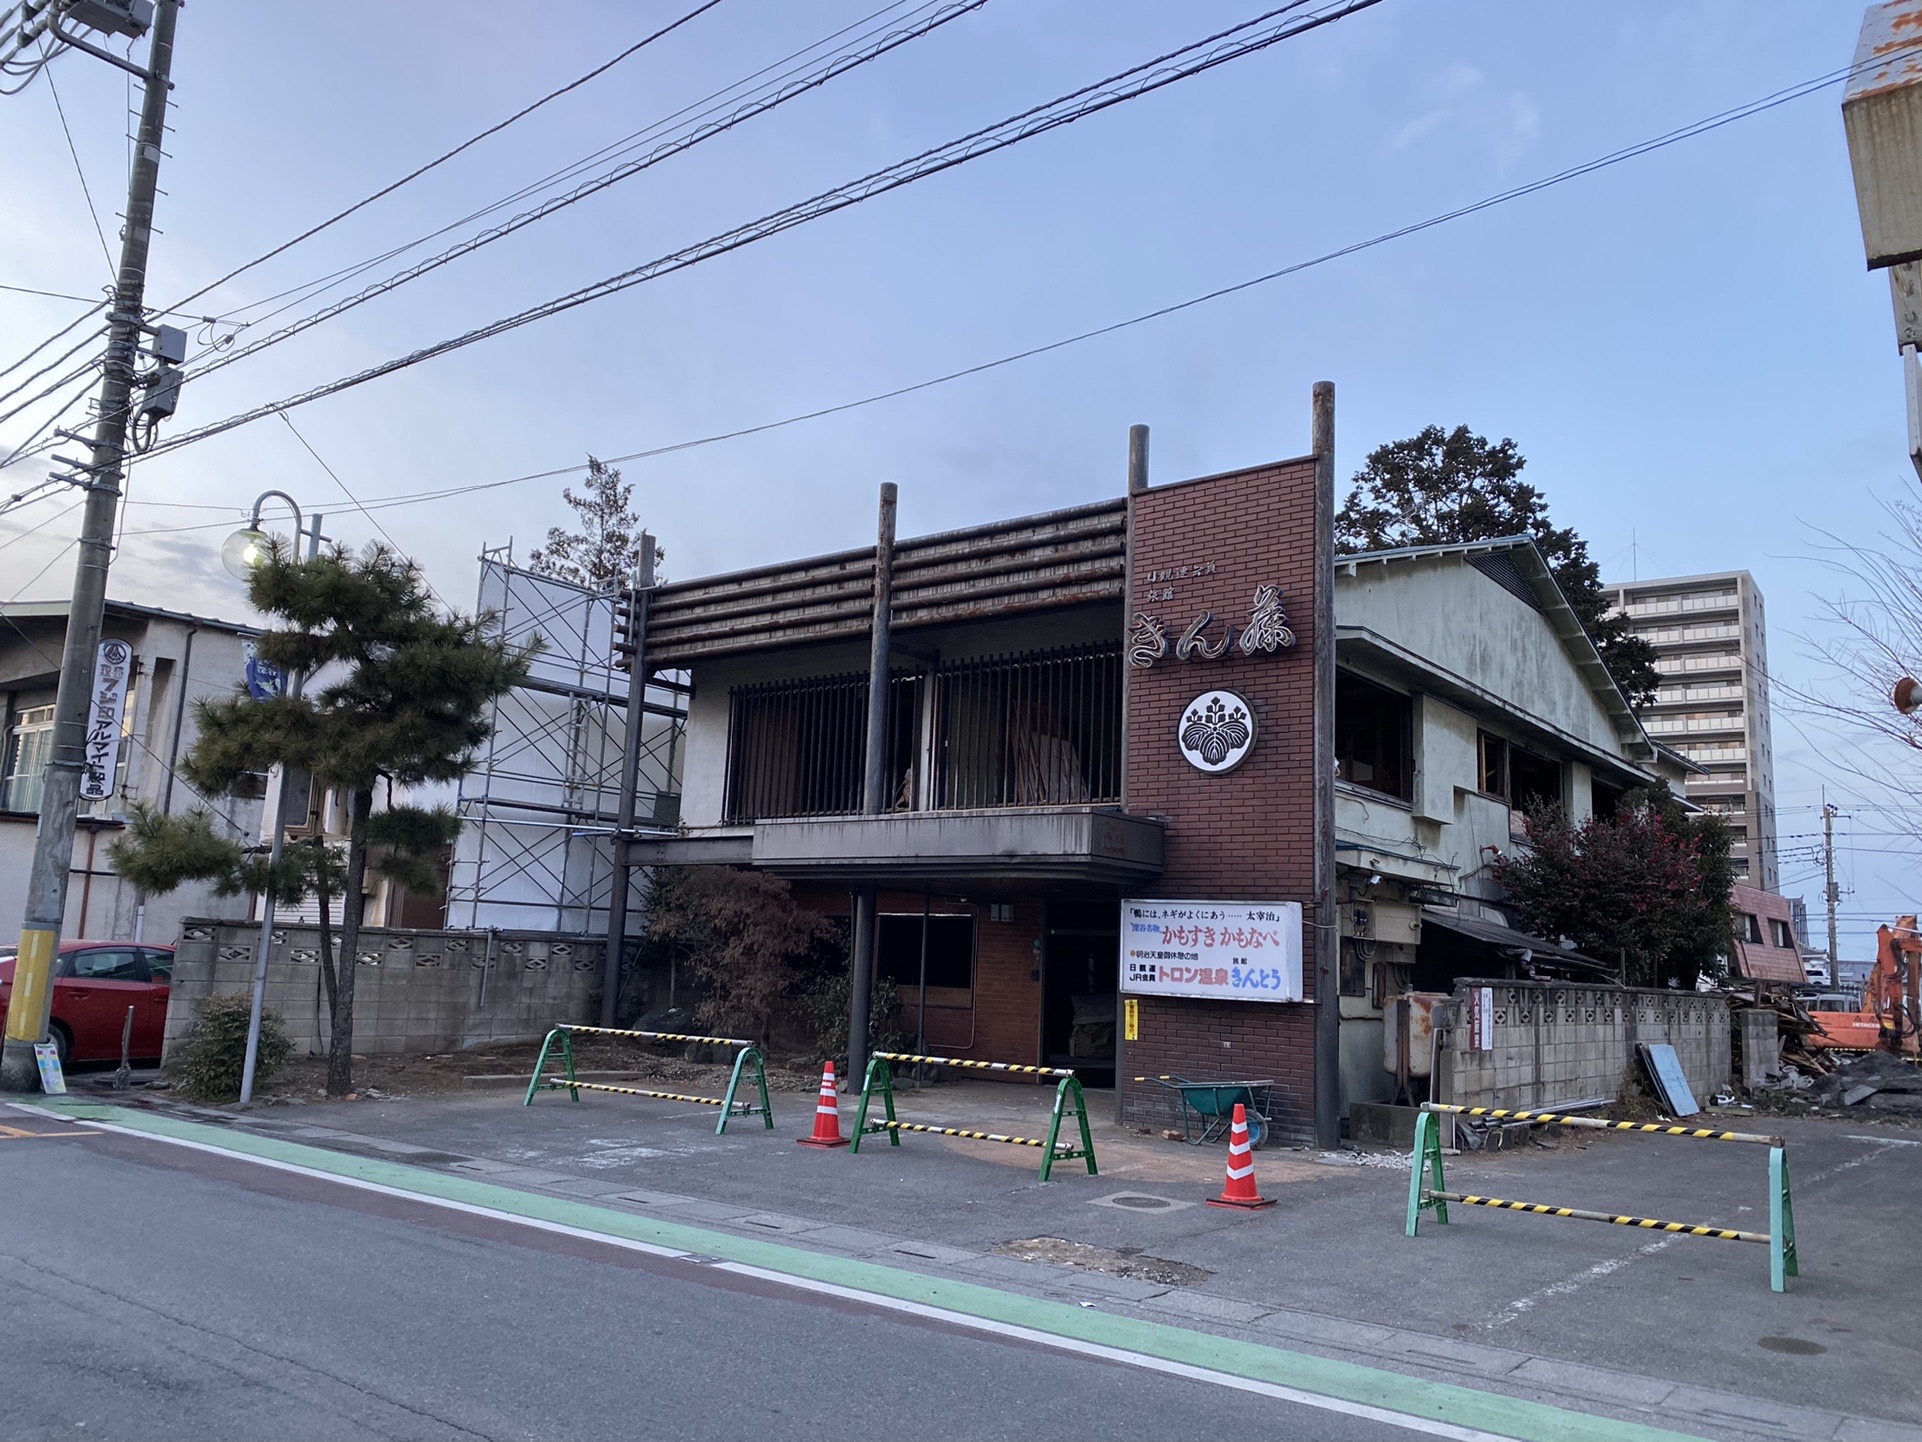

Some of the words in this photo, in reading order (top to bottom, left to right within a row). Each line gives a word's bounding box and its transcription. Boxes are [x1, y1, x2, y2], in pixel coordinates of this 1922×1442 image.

[1128, 584, 1298, 668] きん藤
[1162, 925, 1216, 948] かもすき
[1220, 926, 1280, 949] かもなべ
[1232, 957, 1248, 965] 旅館
[1129, 973, 1156, 982] JR会員
[1158, 965, 1229, 986] トロン温泉
[1231, 966, 1281, 990] きんとう
